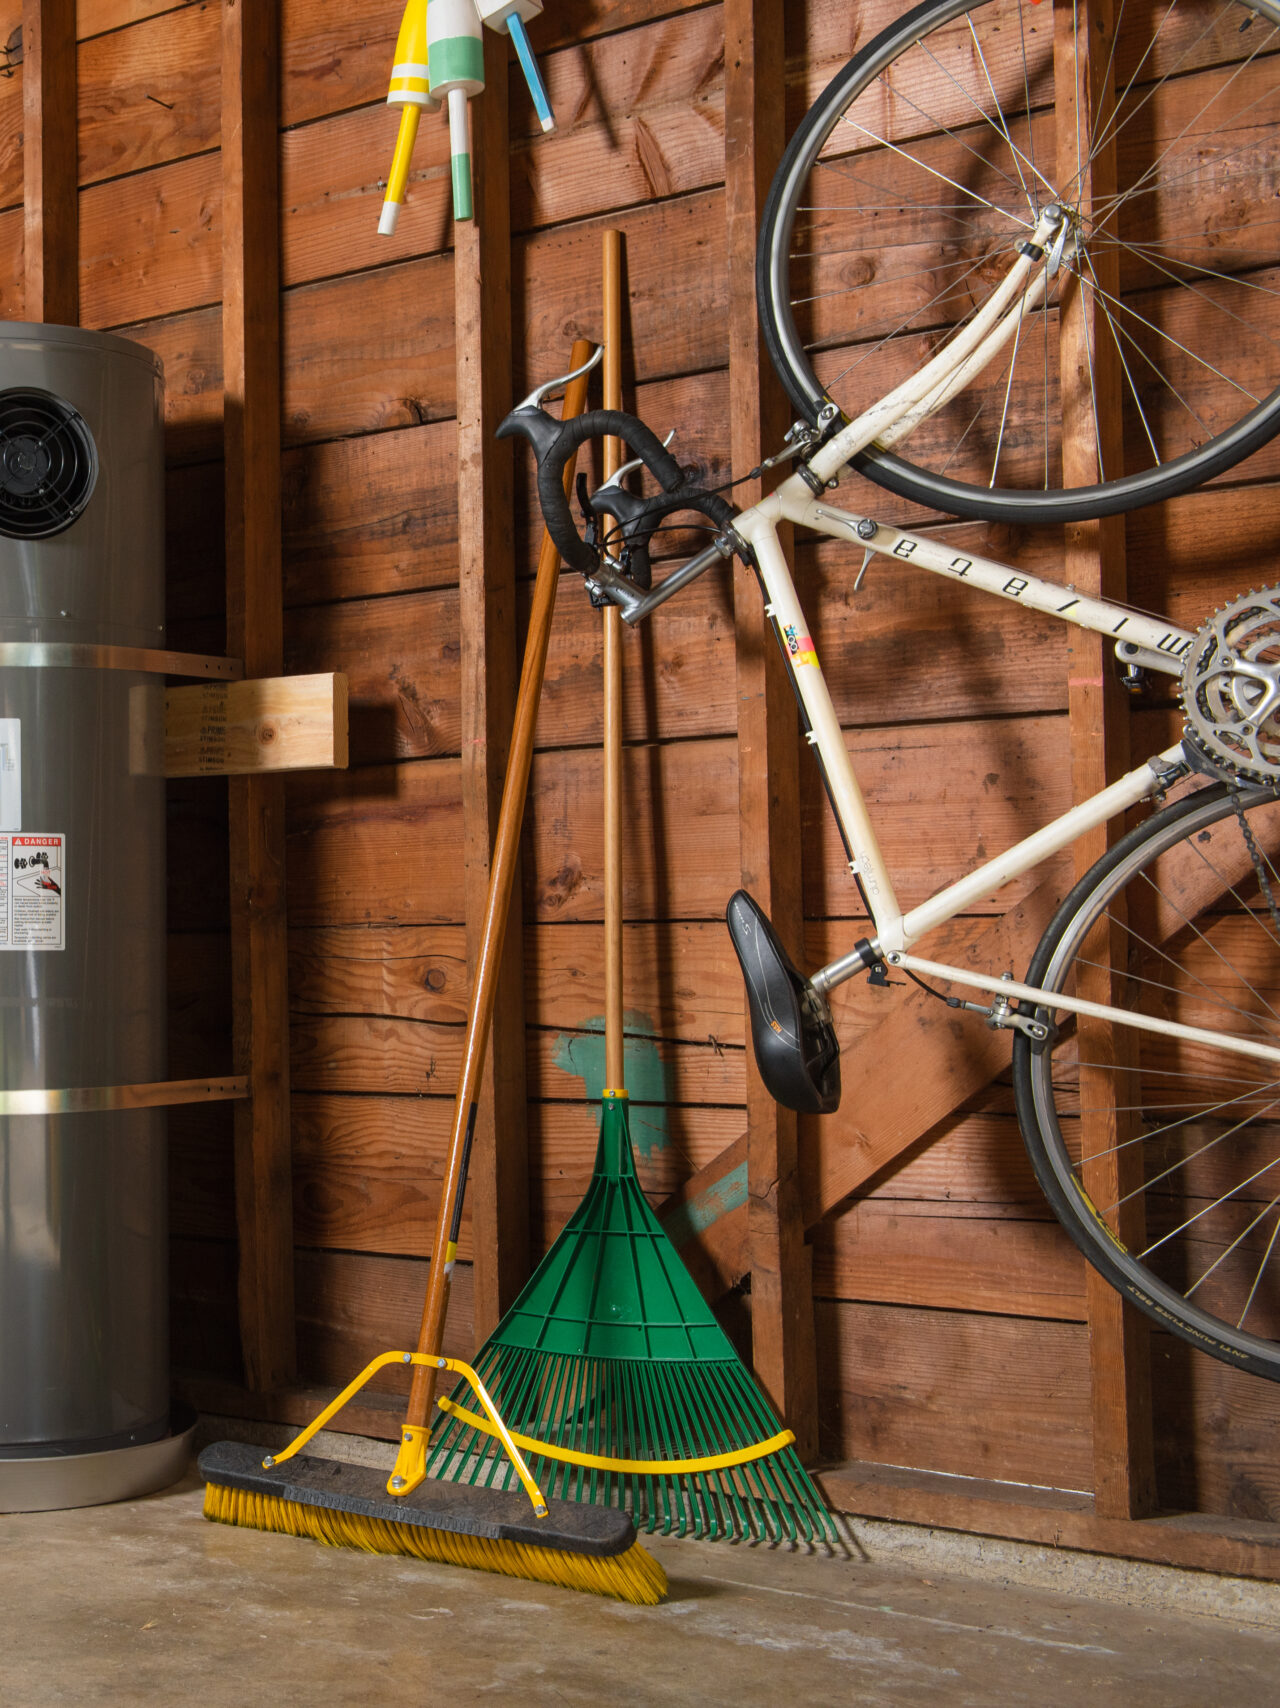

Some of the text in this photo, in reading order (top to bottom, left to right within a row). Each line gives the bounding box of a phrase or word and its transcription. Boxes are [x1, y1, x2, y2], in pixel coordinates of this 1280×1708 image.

[1126, 1284, 1250, 1359] ANTI PUNCTURE BELT
